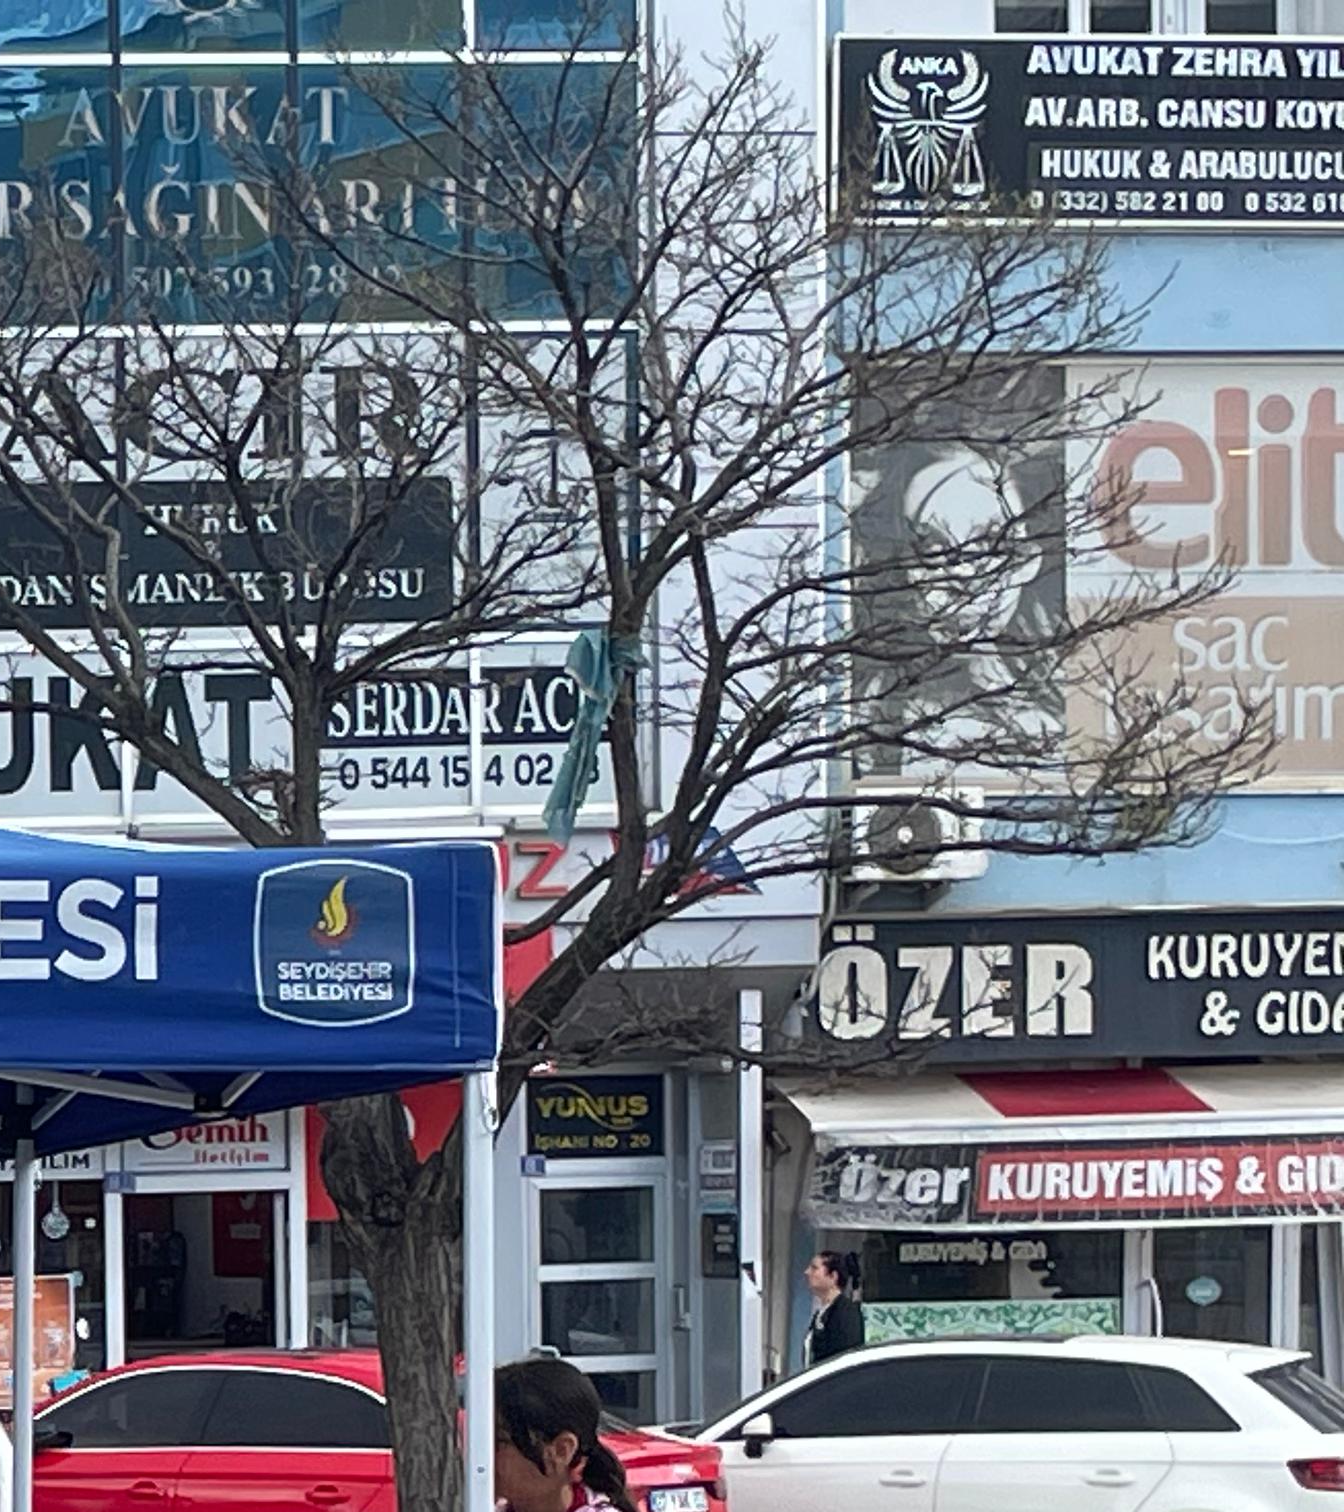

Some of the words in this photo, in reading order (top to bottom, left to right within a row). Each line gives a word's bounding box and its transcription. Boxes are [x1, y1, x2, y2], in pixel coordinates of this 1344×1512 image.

[899, 56, 959, 75] ANKA
[1027, 45, 1161, 76] AVUKAT
[1170, 48, 1287, 77] ZEHRA
[1025, 98, 1148, 128] AV.ARB.
[1157, 99, 1266, 129] CANSU
[1041, 148, 1141, 179] HUKUK
[1149, 149, 1171, 179] &
[1115, 190, 1156, 211] 582
[1162, 191, 1188, 211] 21
[1195, 190, 1224, 211] 00
[1244, 191, 1259, 212] 0
[1265, 191, 1306, 212] 532
[327, 678, 504, 738] SERDAR
[370, 756, 431, 789] 544
[514, 753, 553, 786] 02
[818, 924, 1096, 1041] ÖZER
[1200, 990, 1242, 1036] &
[536, 1095, 649, 1119] YUNUS
[988, 1156, 1224, 1202] KURUYEMİŞ
[1235, 1156, 1265, 1195] &
